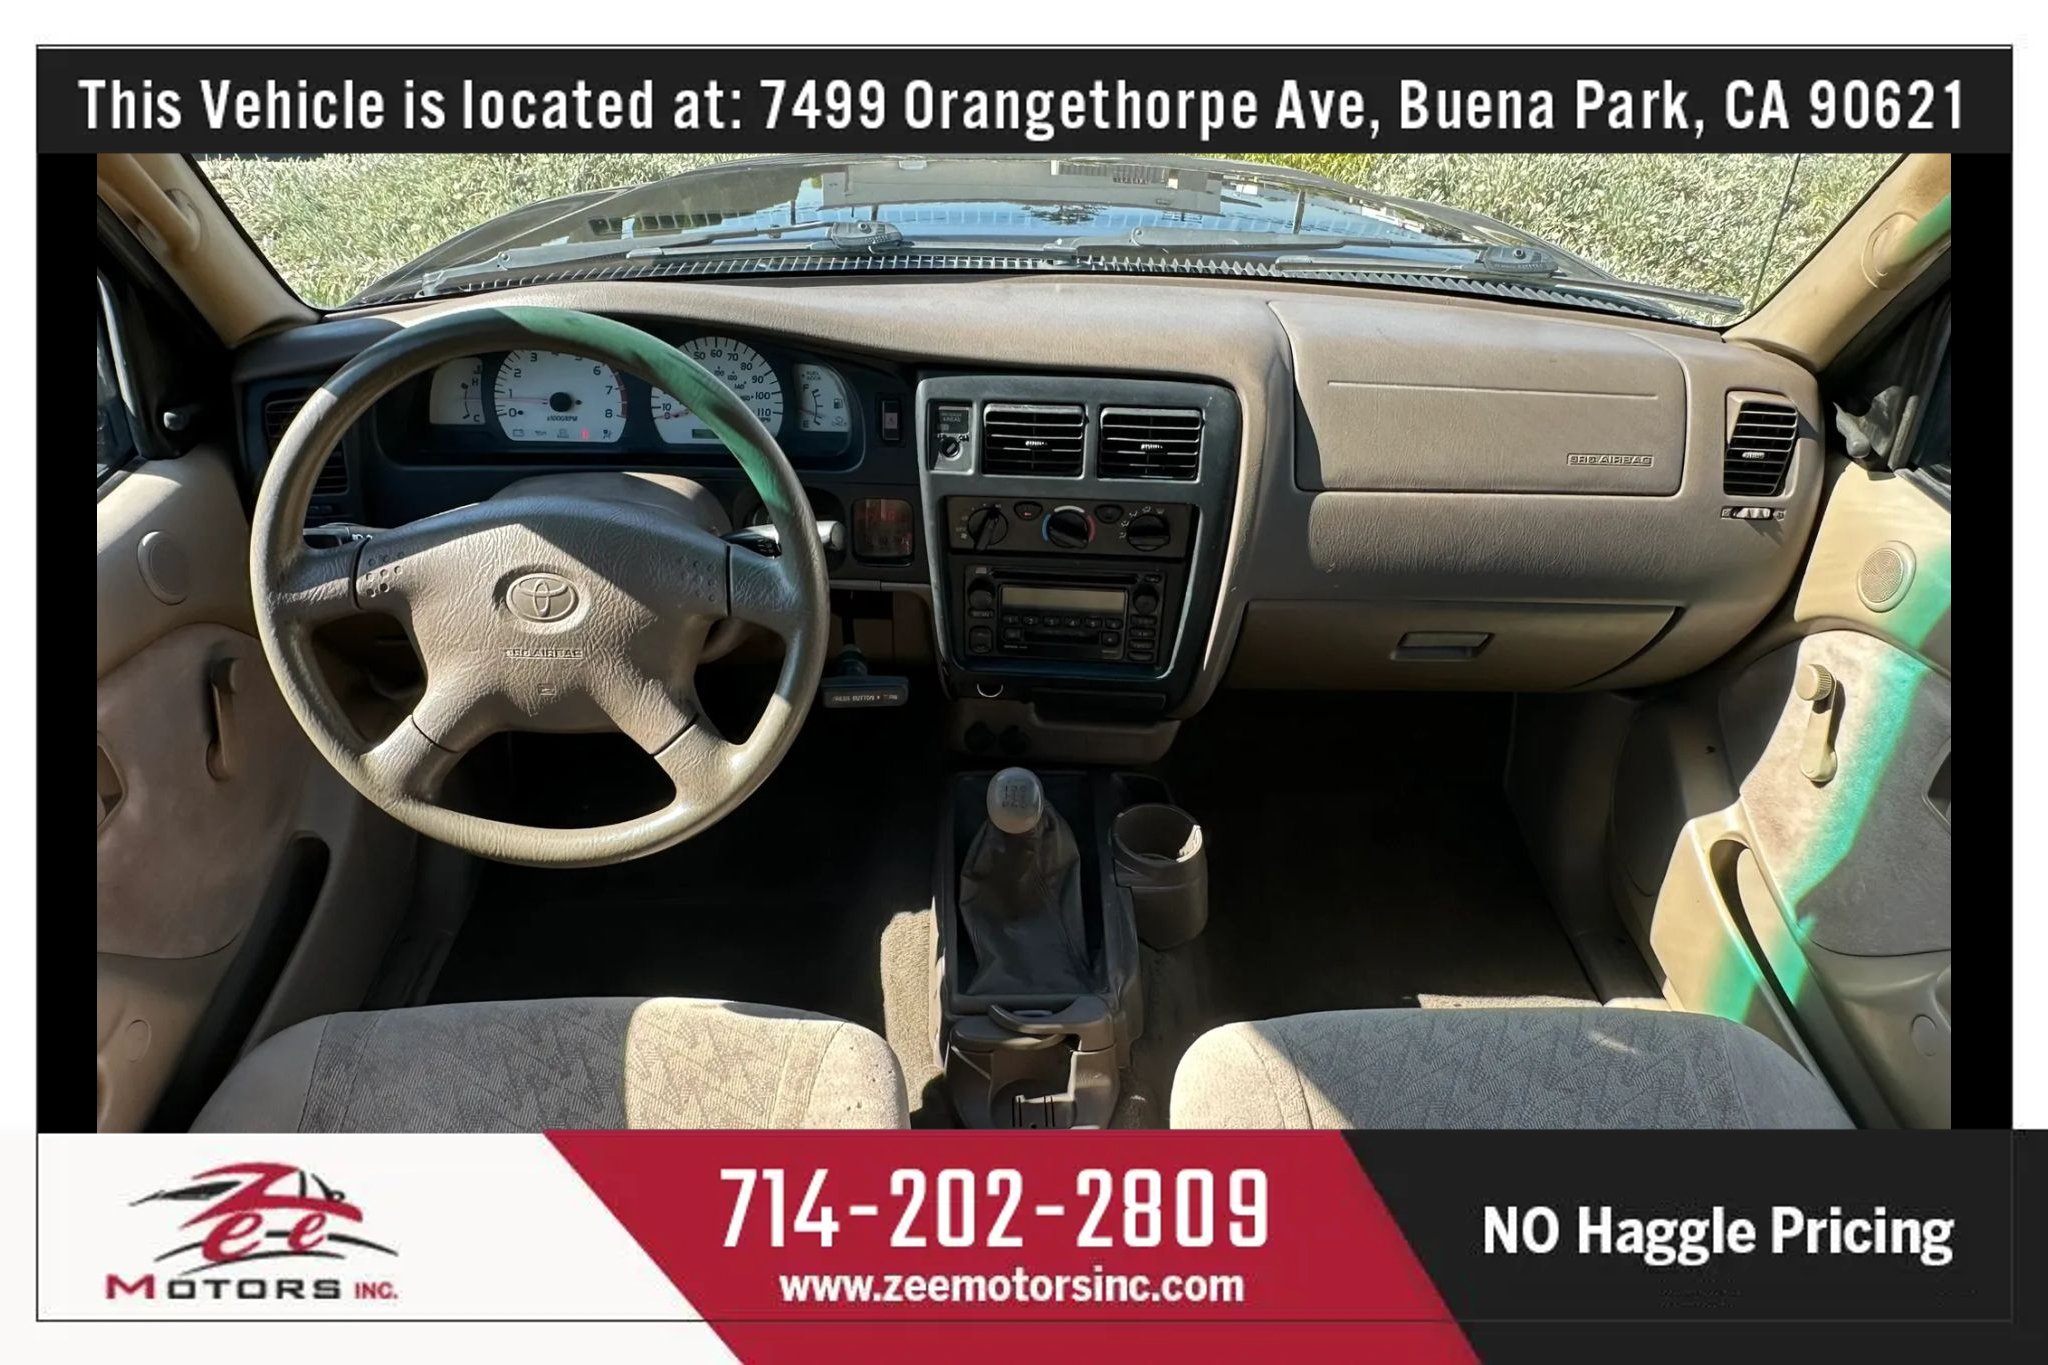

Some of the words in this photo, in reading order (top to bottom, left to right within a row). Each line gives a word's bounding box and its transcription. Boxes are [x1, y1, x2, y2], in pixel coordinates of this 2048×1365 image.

[694, 352, 706, 360] 50
[711, 349, 723, 358] 60
[728, 353, 739, 361] 70
[593, 366, 601, 376] 6
[741, 362, 753, 371] 80
[514, 368, 522, 378] 2
[752, 376, 764, 384] 90
[755, 392, 771, 400] 100
[605, 409, 613, 418] 8
[757, 407, 772, 416] 110
[1599, 456, 1652, 466] AIRBAG
